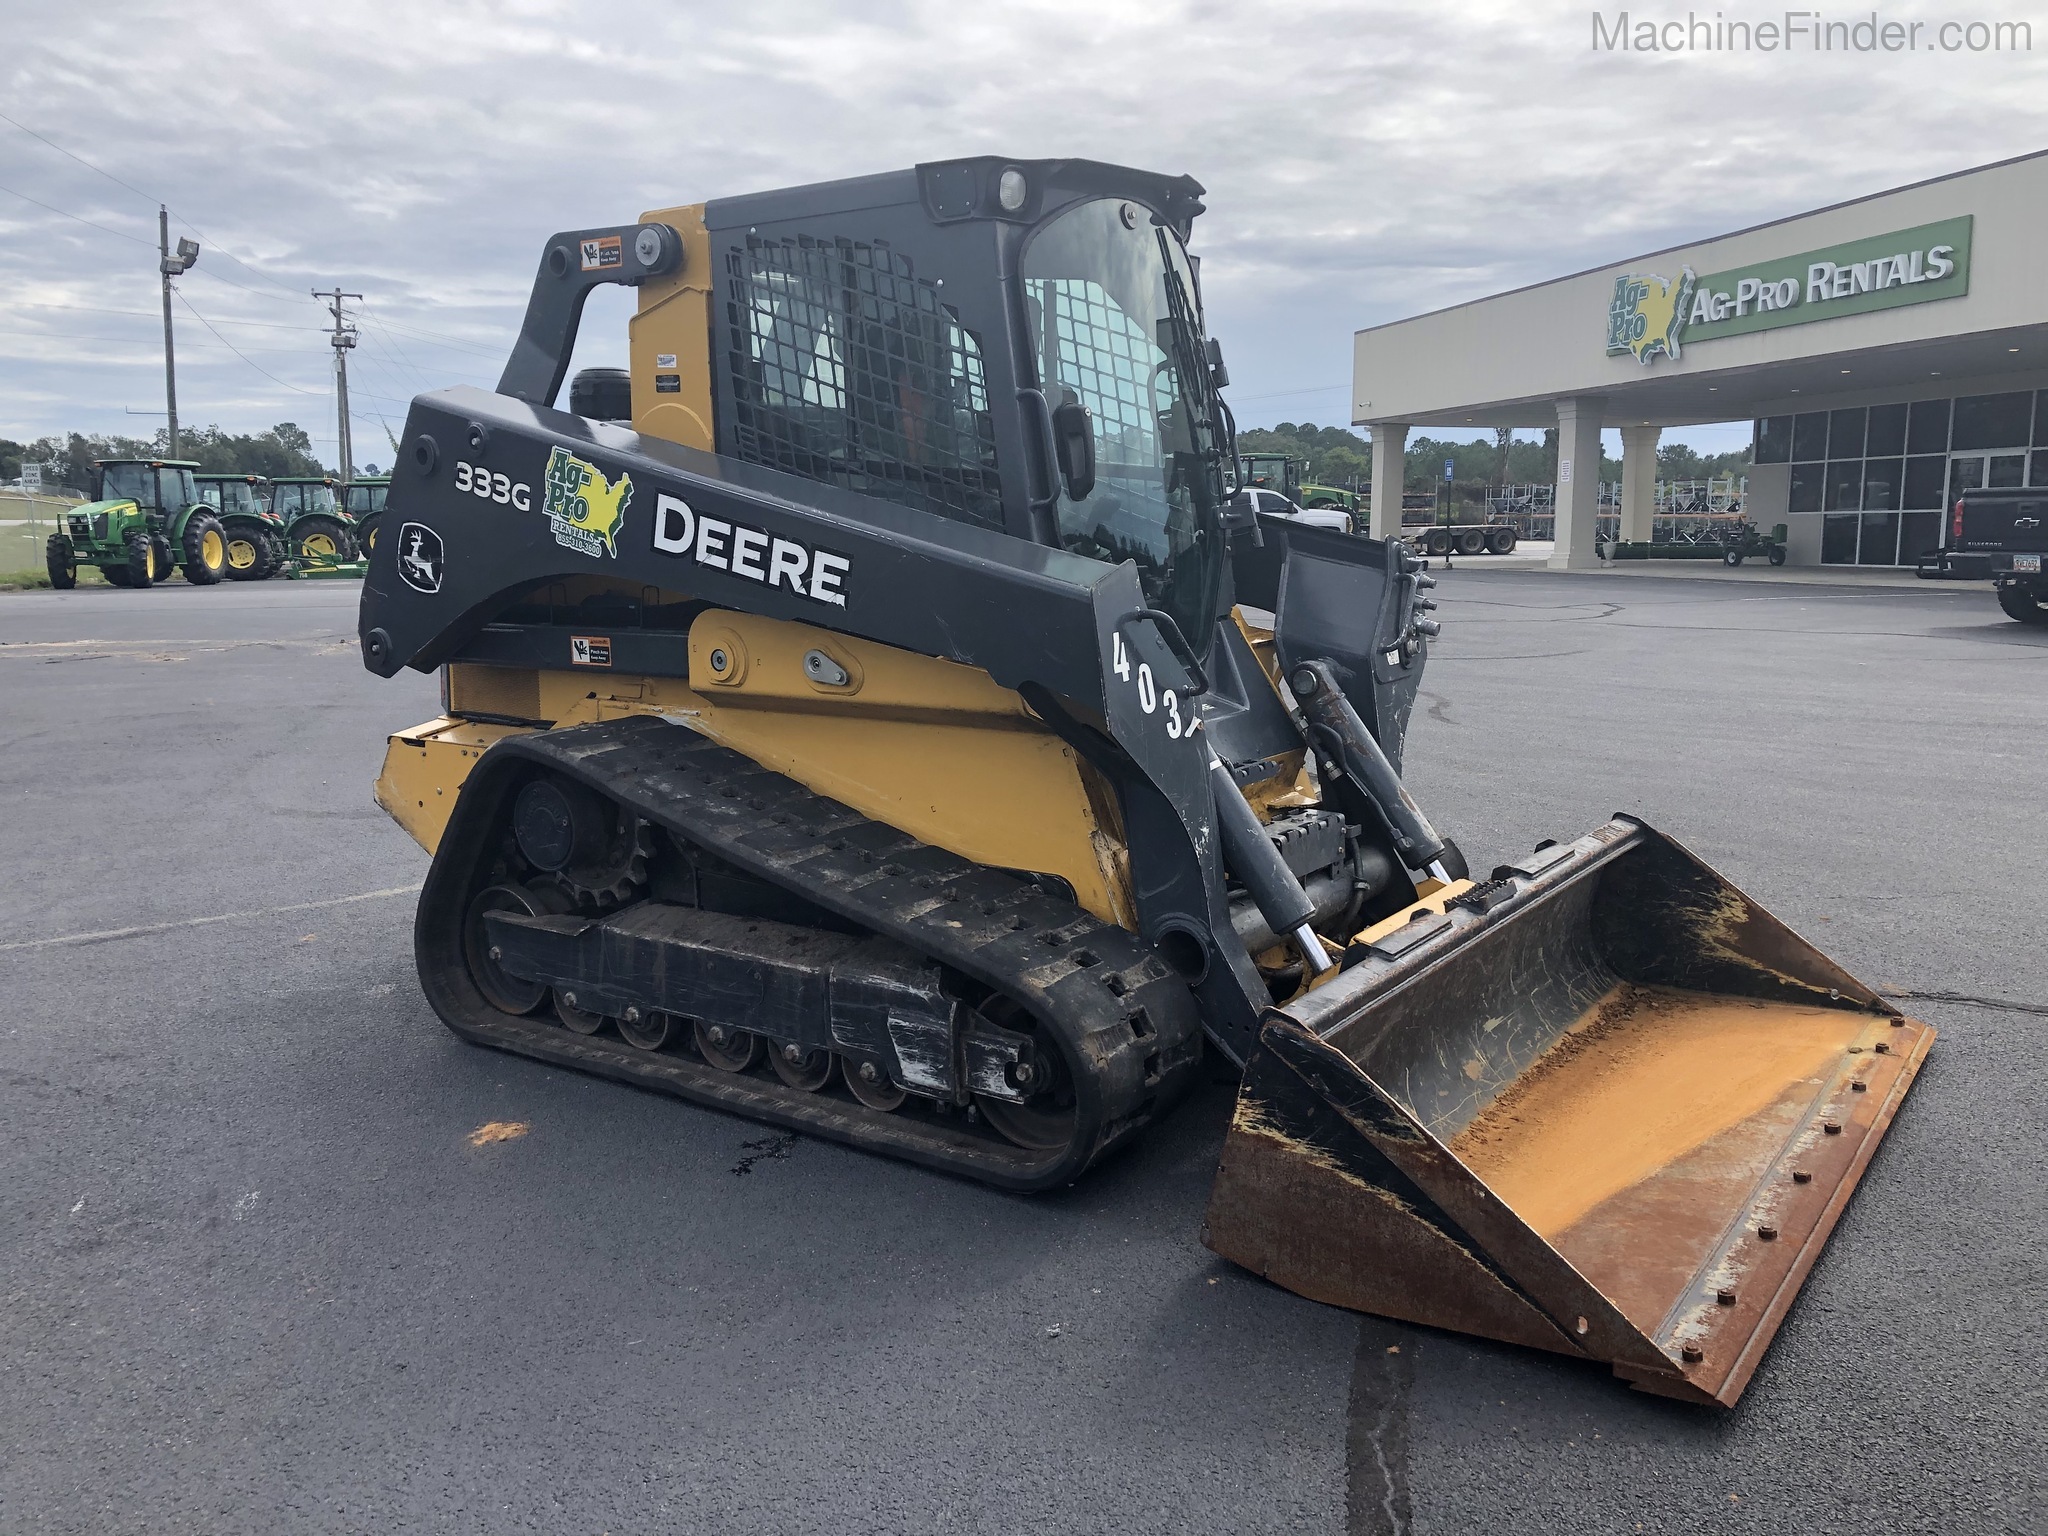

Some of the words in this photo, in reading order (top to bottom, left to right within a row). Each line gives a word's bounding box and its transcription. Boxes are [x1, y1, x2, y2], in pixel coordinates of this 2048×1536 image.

[1807, 245, 1954, 303] RENTALS
[1610, 276, 1649, 317] Ag-
[1609, 311, 1647, 343] Pro
[455, 461, 531, 511] 333G
[548, 449, 592, 494] Ag-
[545, 481, 589, 522] Pro
[553, 519, 595, 542] RENTALS
[557, 533, 600, 555] 855-310-3600
[653, 494, 850, 609] DEERE
